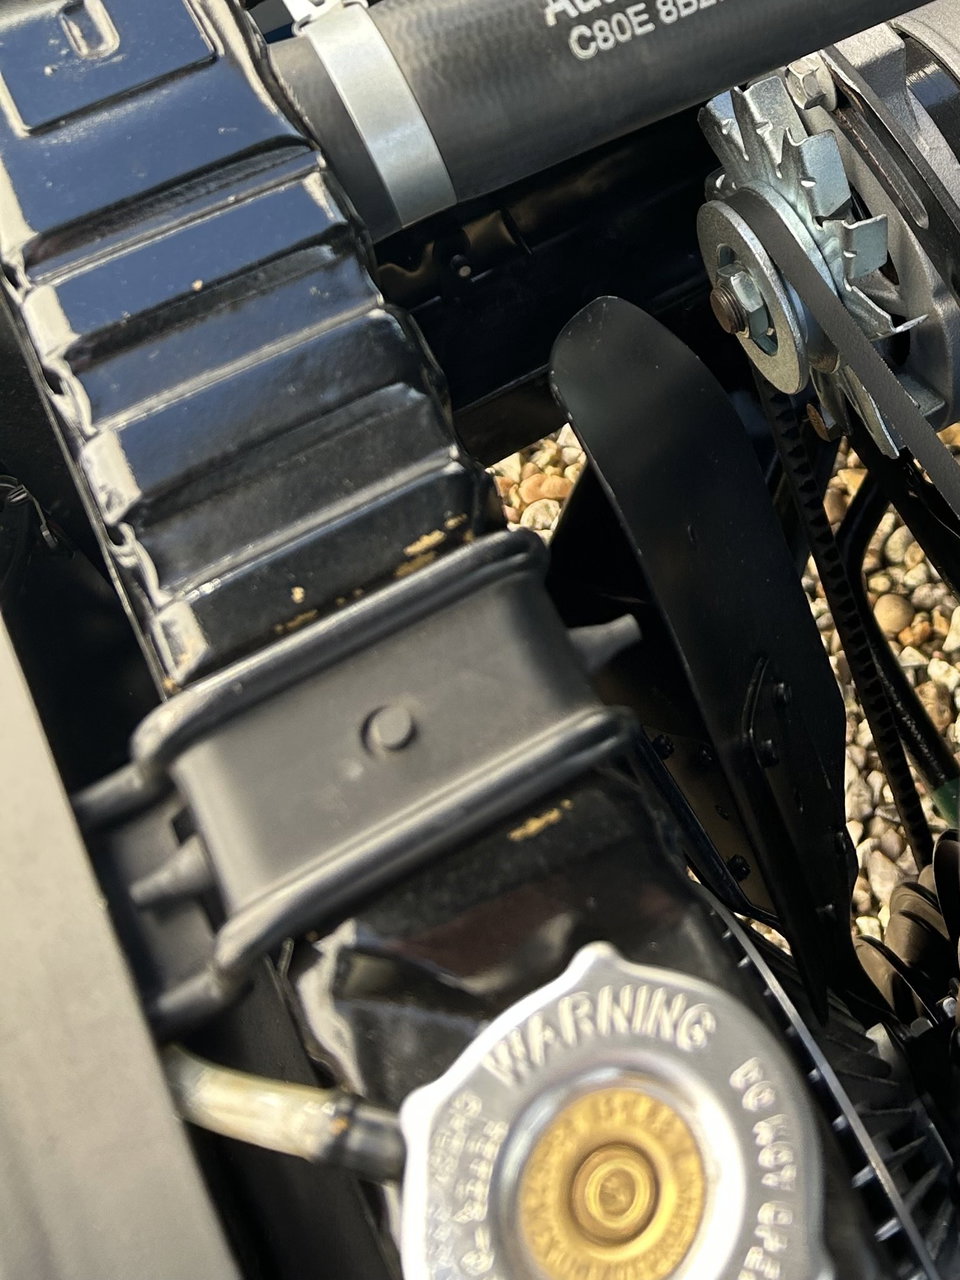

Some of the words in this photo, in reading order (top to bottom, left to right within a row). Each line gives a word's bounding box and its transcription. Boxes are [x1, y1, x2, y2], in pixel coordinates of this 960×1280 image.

[481, 983, 716, 1089] WARNING
[729, 1056, 777, 1112] DO
[752, 1113, 798, 1192] NOT
